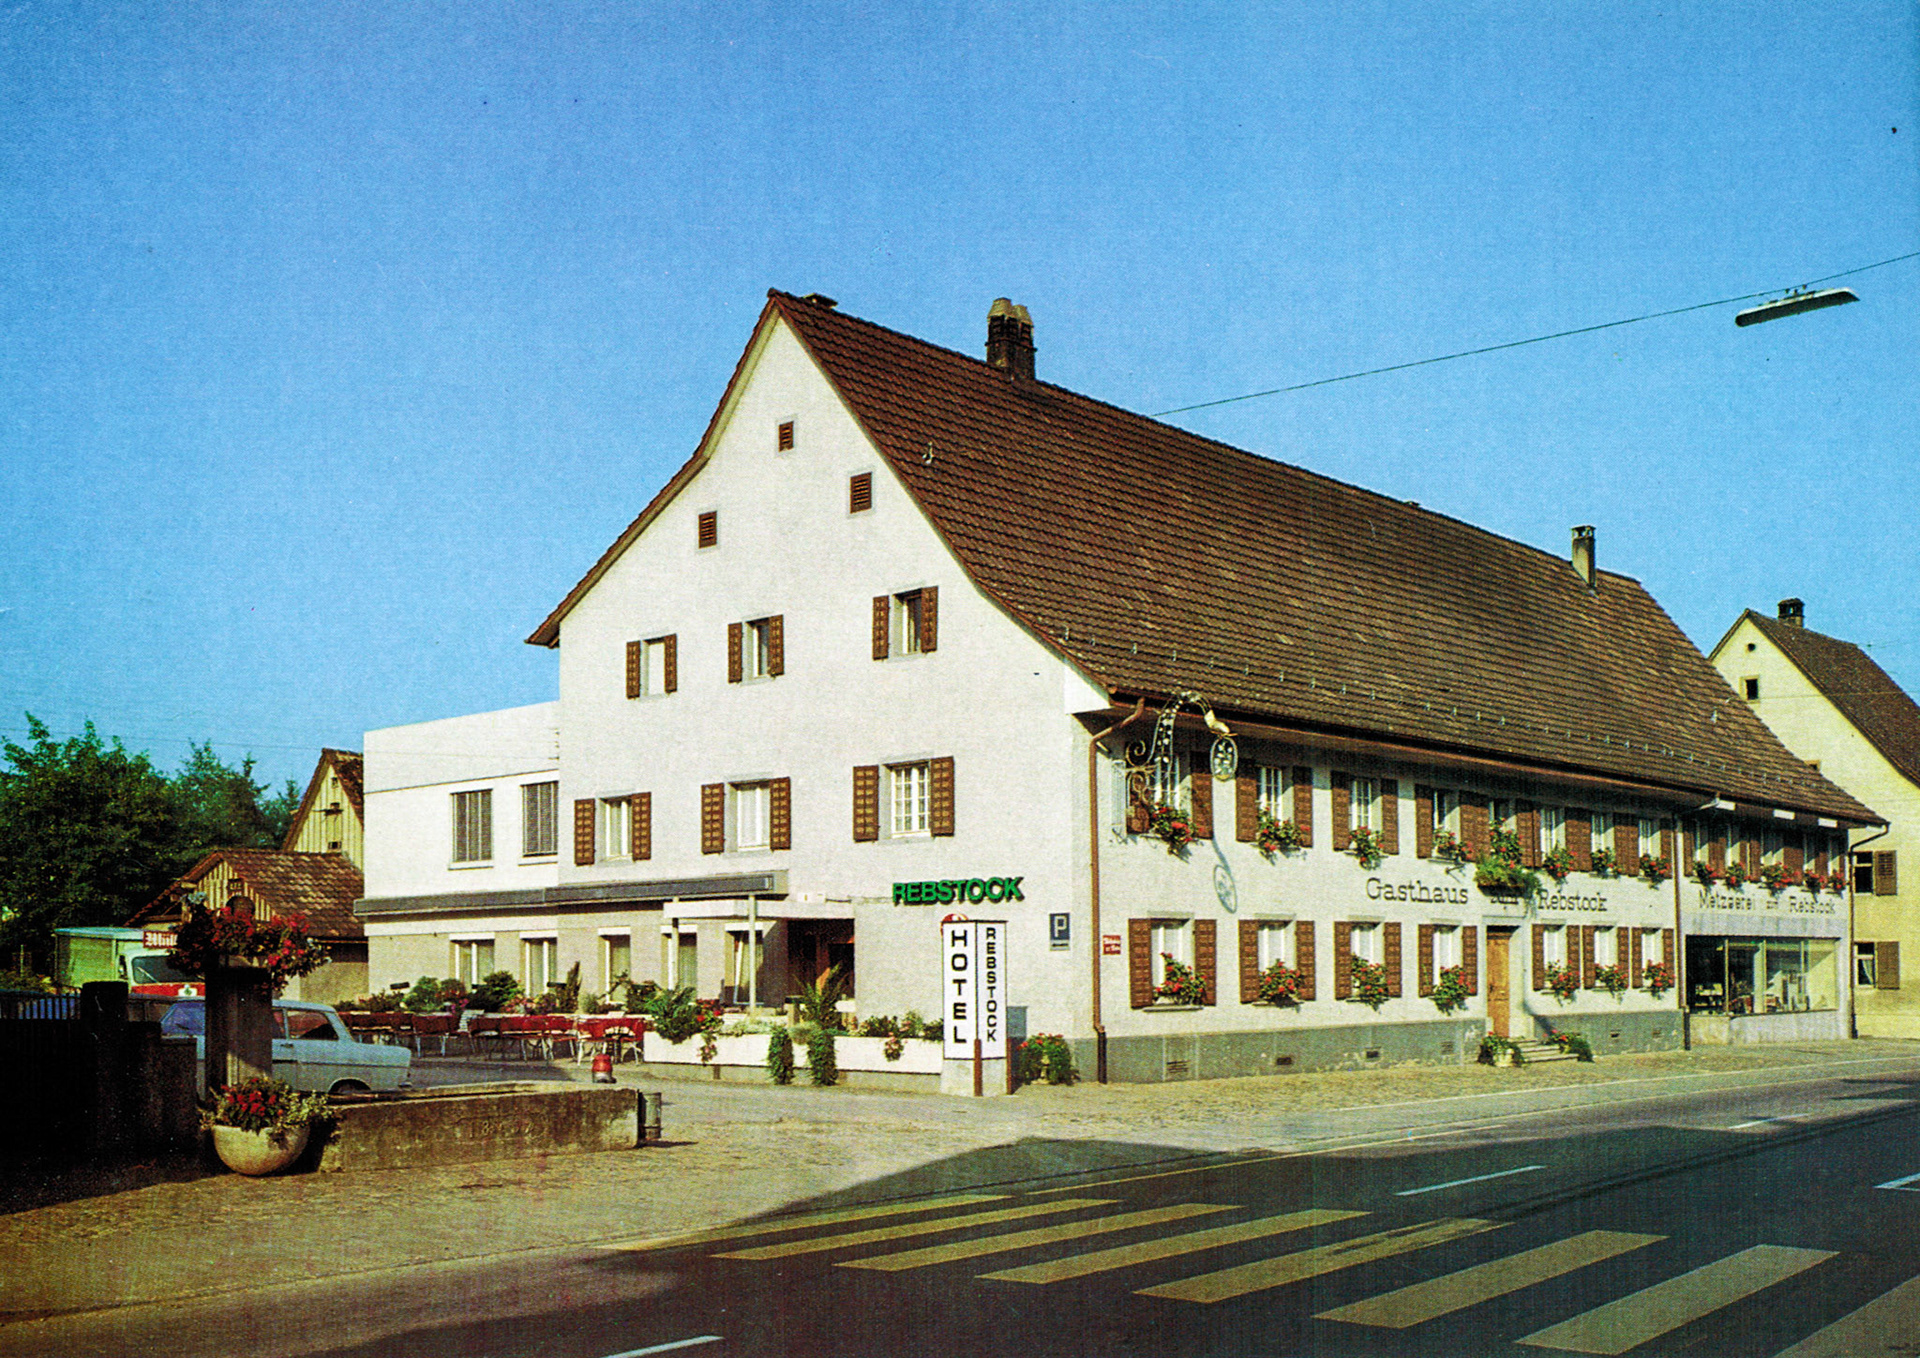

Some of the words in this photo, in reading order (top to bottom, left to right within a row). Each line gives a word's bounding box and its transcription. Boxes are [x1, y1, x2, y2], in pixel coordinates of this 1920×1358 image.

[892, 876, 1025, 906] REBSTOCK
[1366, 877, 1469, 905] Gasthaus
[1537, 888, 1608, 912] Rebstock
[1054, 915, 1068, 938] P
[951, 929, 969, 1045] HOTEL
[985, 927, 998, 1043] REBSTOCK
